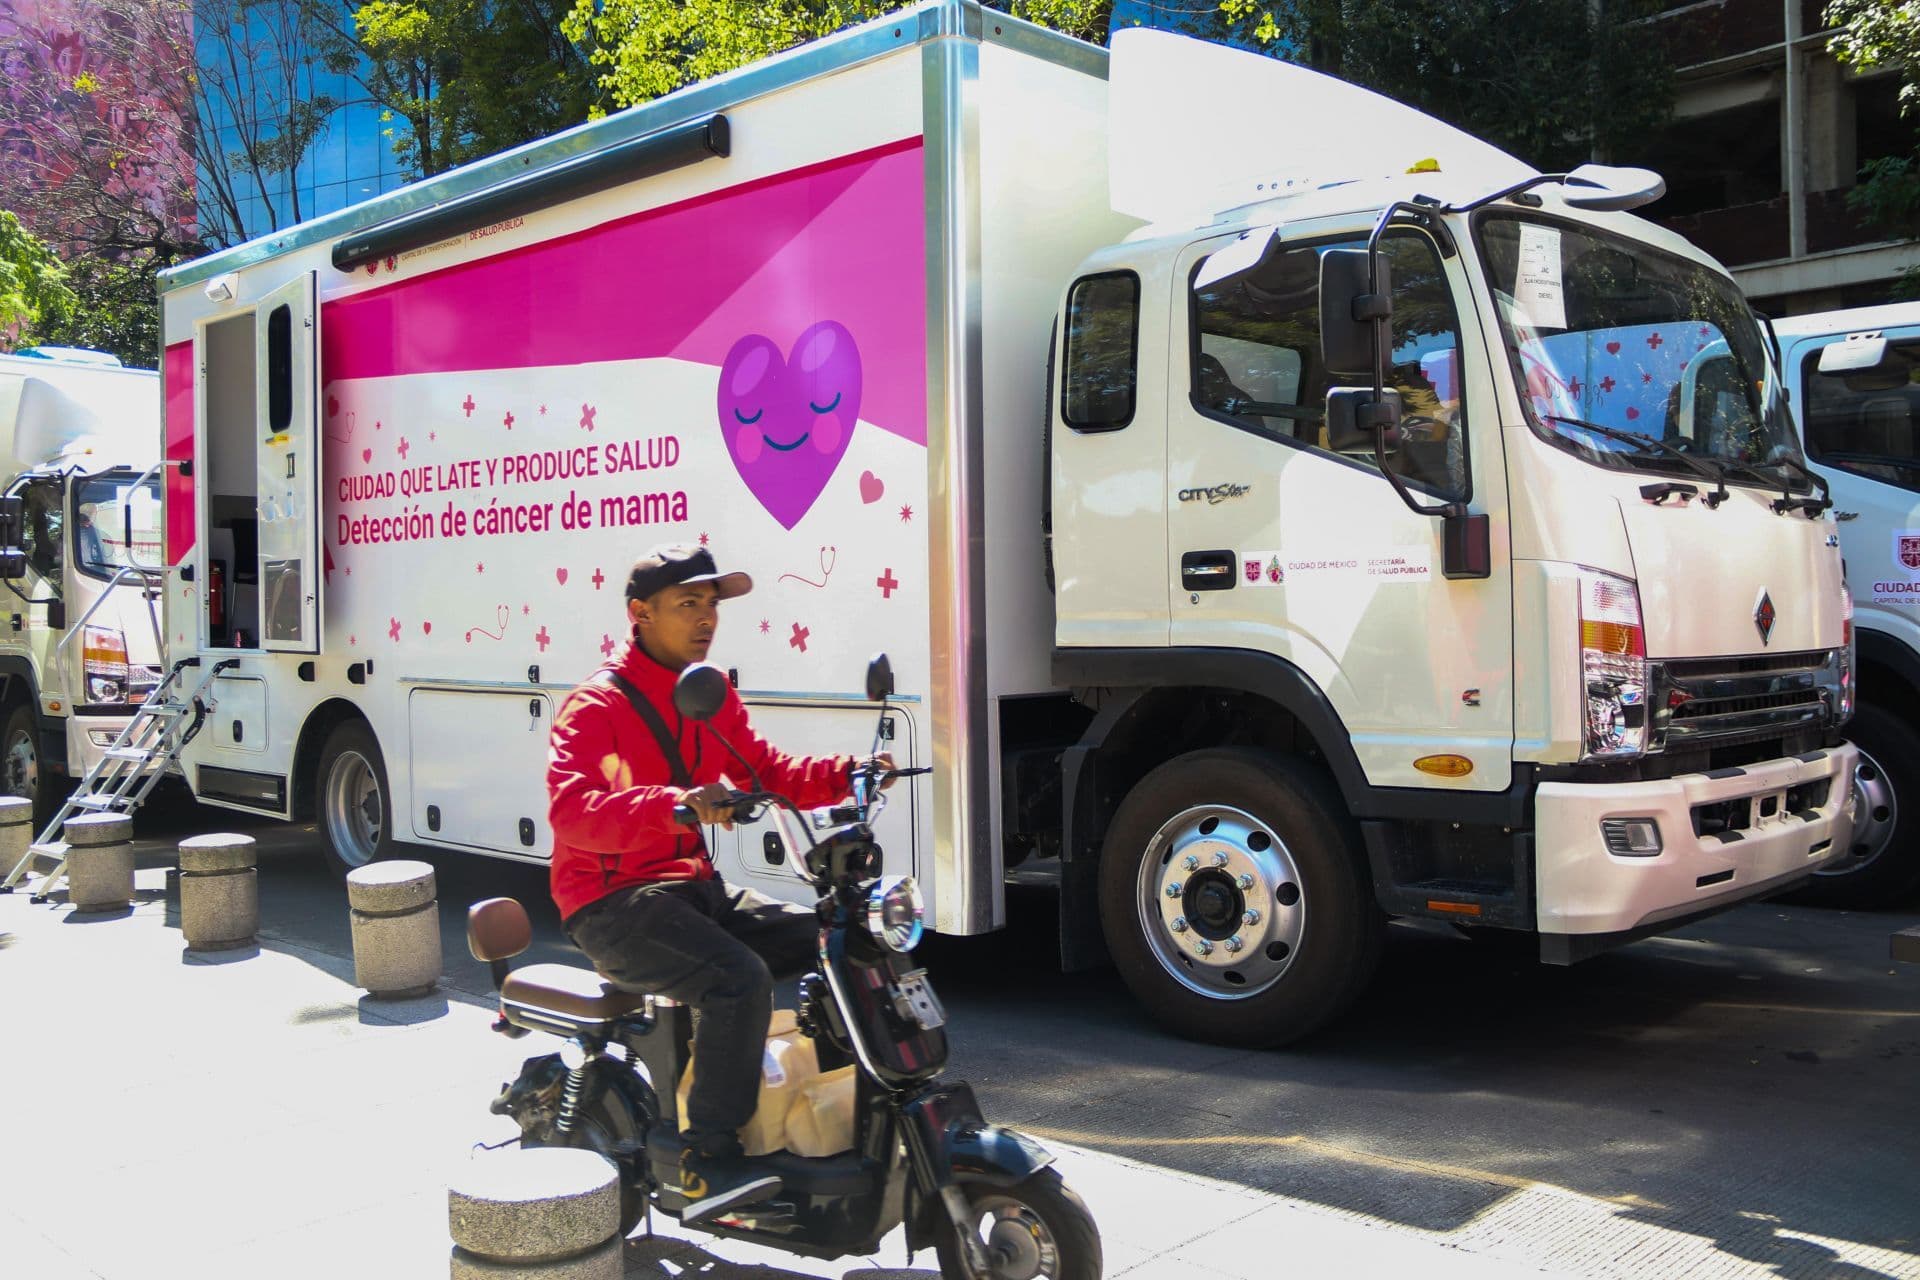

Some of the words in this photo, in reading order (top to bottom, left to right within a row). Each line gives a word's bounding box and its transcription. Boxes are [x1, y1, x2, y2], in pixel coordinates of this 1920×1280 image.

[469, 230, 478, 241] DE
[479, 225, 498, 239] SALUD
[339, 472, 396, 503] CIUDAD
[401, 466, 433, 498] QUE
[438, 460, 481, 491] LATE
[485, 459, 498, 486] Y
[503, 446, 599, 484] PRODUCE
[605, 436, 680, 473] SALUD
[338, 505, 434, 546] Detección
[441, 501, 467, 537] de
[473, 497, 553, 536] cáncer
[561, 490, 592, 530] de
[600, 491, 688, 527] mama
[1288, 562, 1316, 570] CIUDAD
[1317, 561, 1328, 569] DE
[1378, 567, 1399, 575] SALUD
